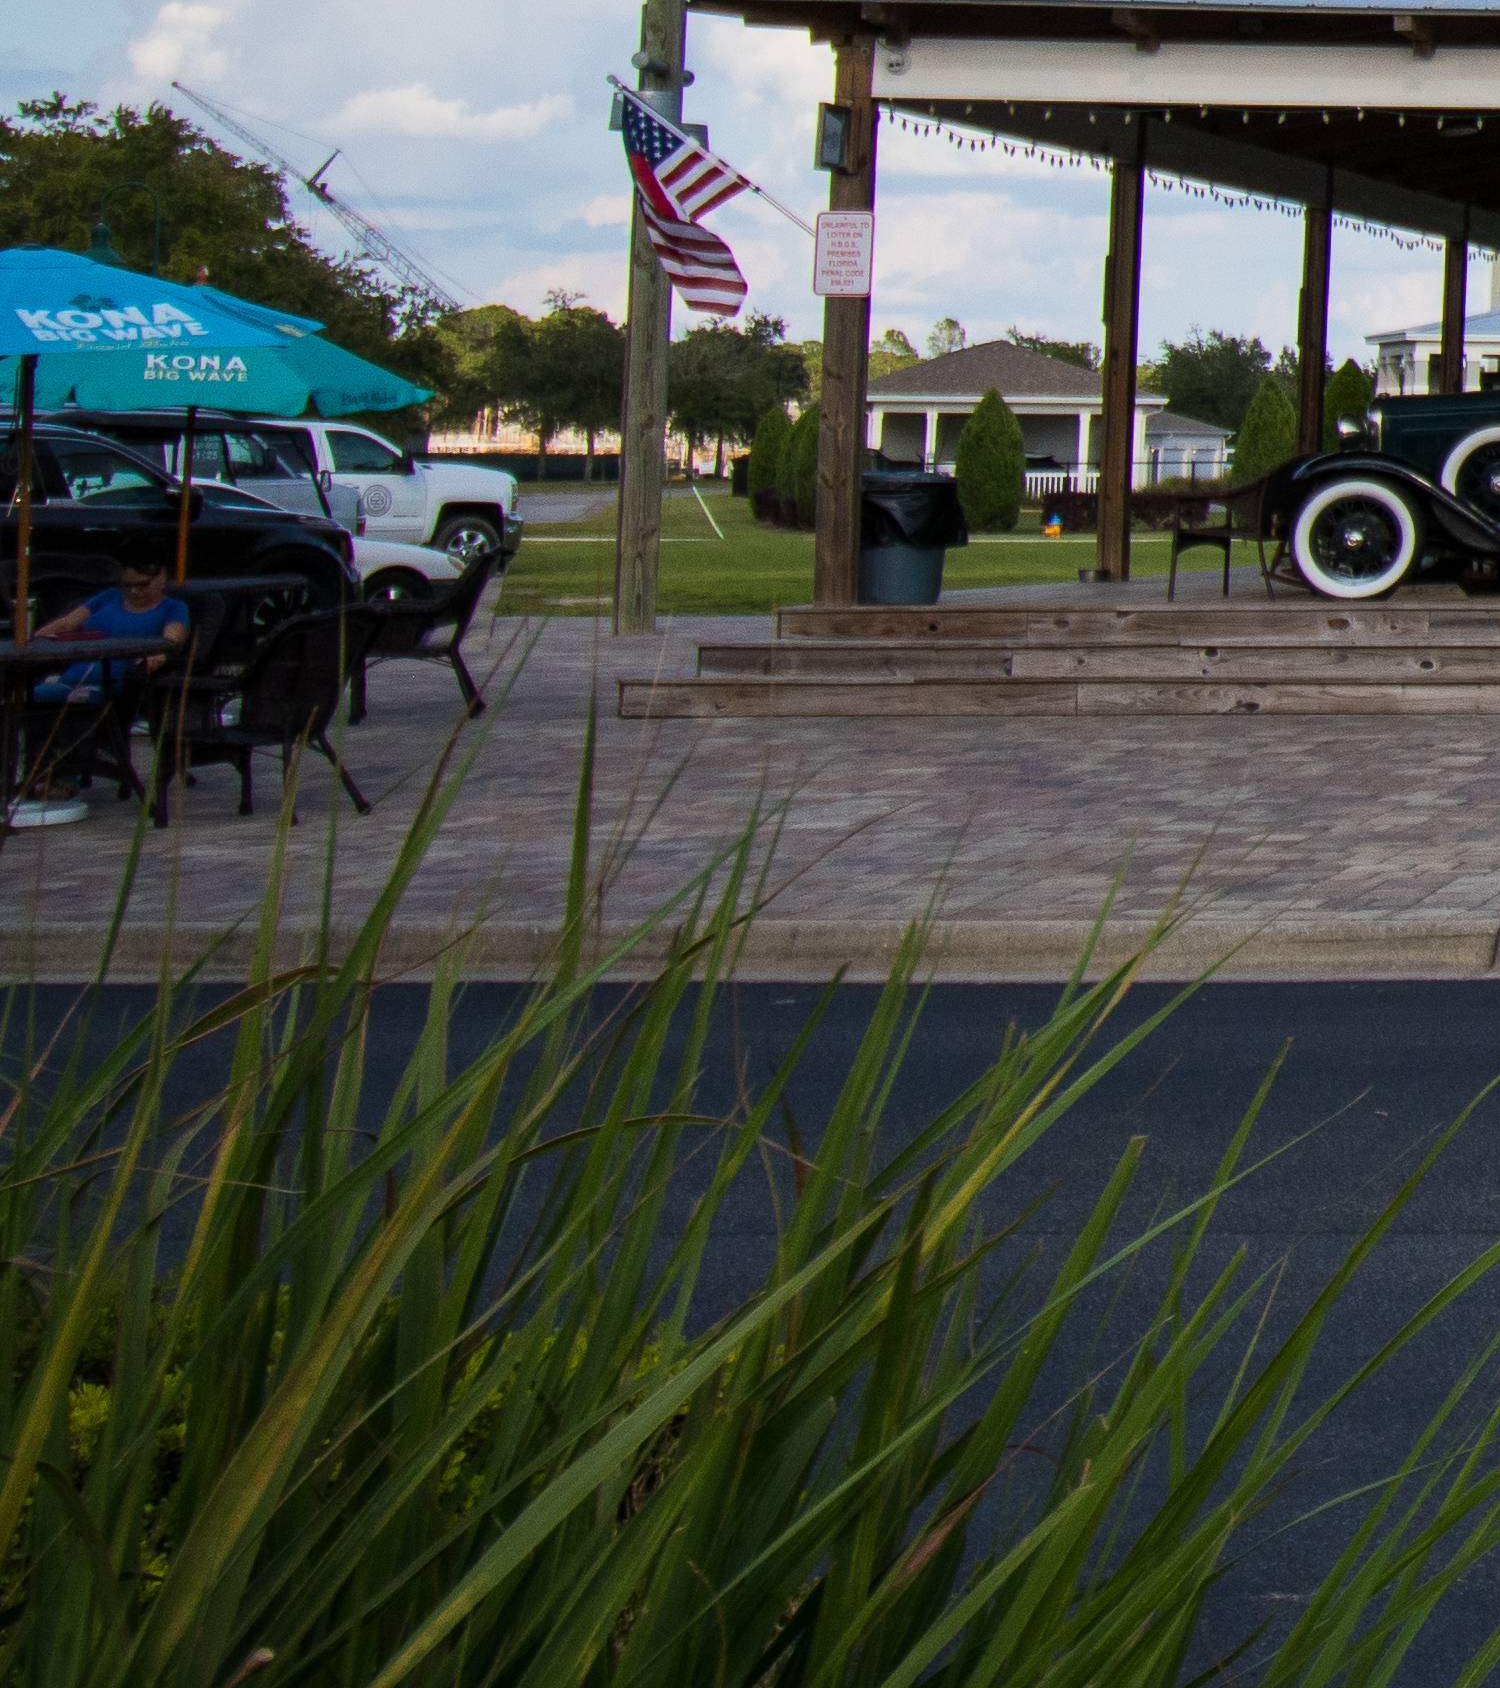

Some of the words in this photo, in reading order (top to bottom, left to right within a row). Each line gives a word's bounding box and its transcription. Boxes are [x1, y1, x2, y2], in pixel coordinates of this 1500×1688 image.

[14, 302, 196, 332] KONA
[31, 328, 97, 342] BIG
[100, 322, 210, 341] WAVE
[145, 353, 247, 371] KONA
[143, 370, 181, 381] BIG
[188, 370, 249, 382] WAVE
